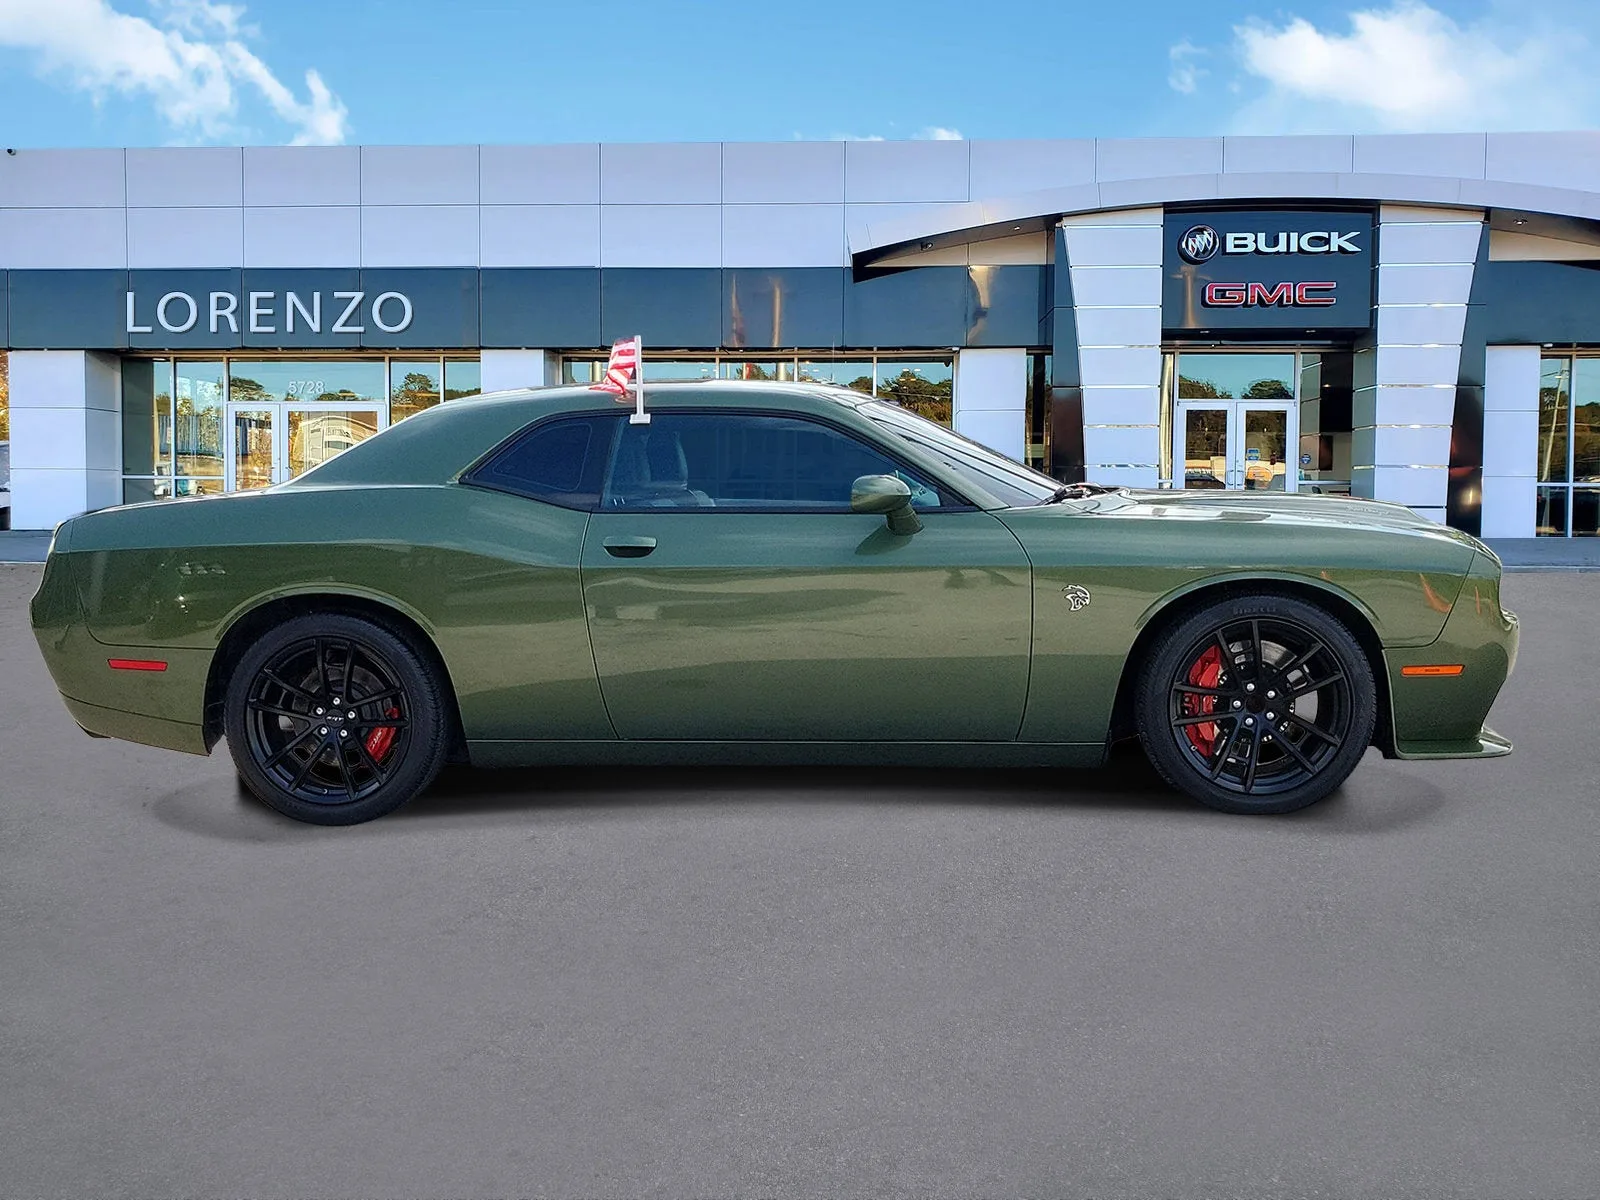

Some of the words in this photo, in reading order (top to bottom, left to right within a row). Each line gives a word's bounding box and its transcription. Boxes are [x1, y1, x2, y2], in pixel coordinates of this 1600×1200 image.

[1225, 231, 1362, 254] BUICK
[1205, 281, 1337, 306] GMC
[126, 291, 413, 333] LORENZO
[288, 381, 325, 394] 5728
